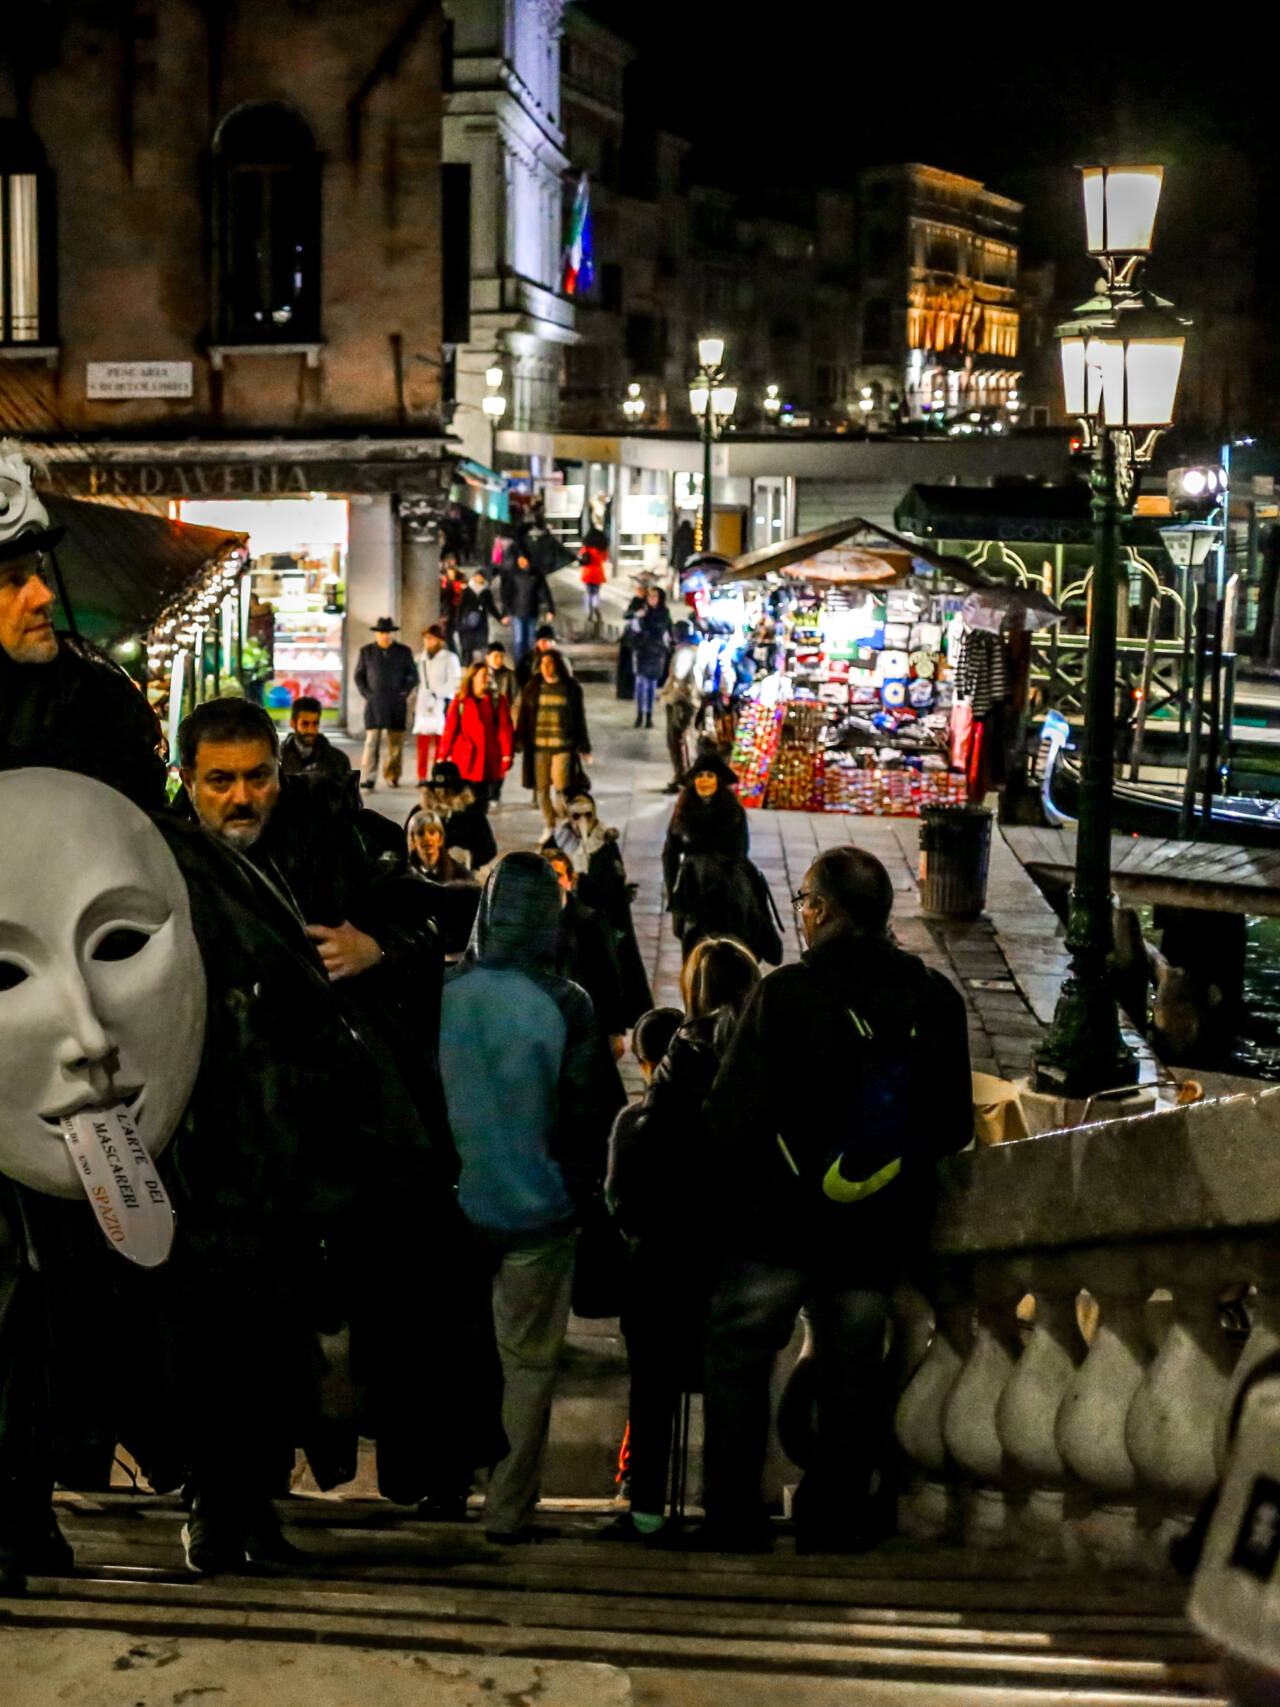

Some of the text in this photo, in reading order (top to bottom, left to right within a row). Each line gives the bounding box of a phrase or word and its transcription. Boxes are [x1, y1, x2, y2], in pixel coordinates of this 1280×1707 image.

[92, 1122, 140, 1209] MASCARERI
[116, 1113, 165, 1204] L'ARTE DEI
[92, 1185, 126, 1243] SPAZIO
